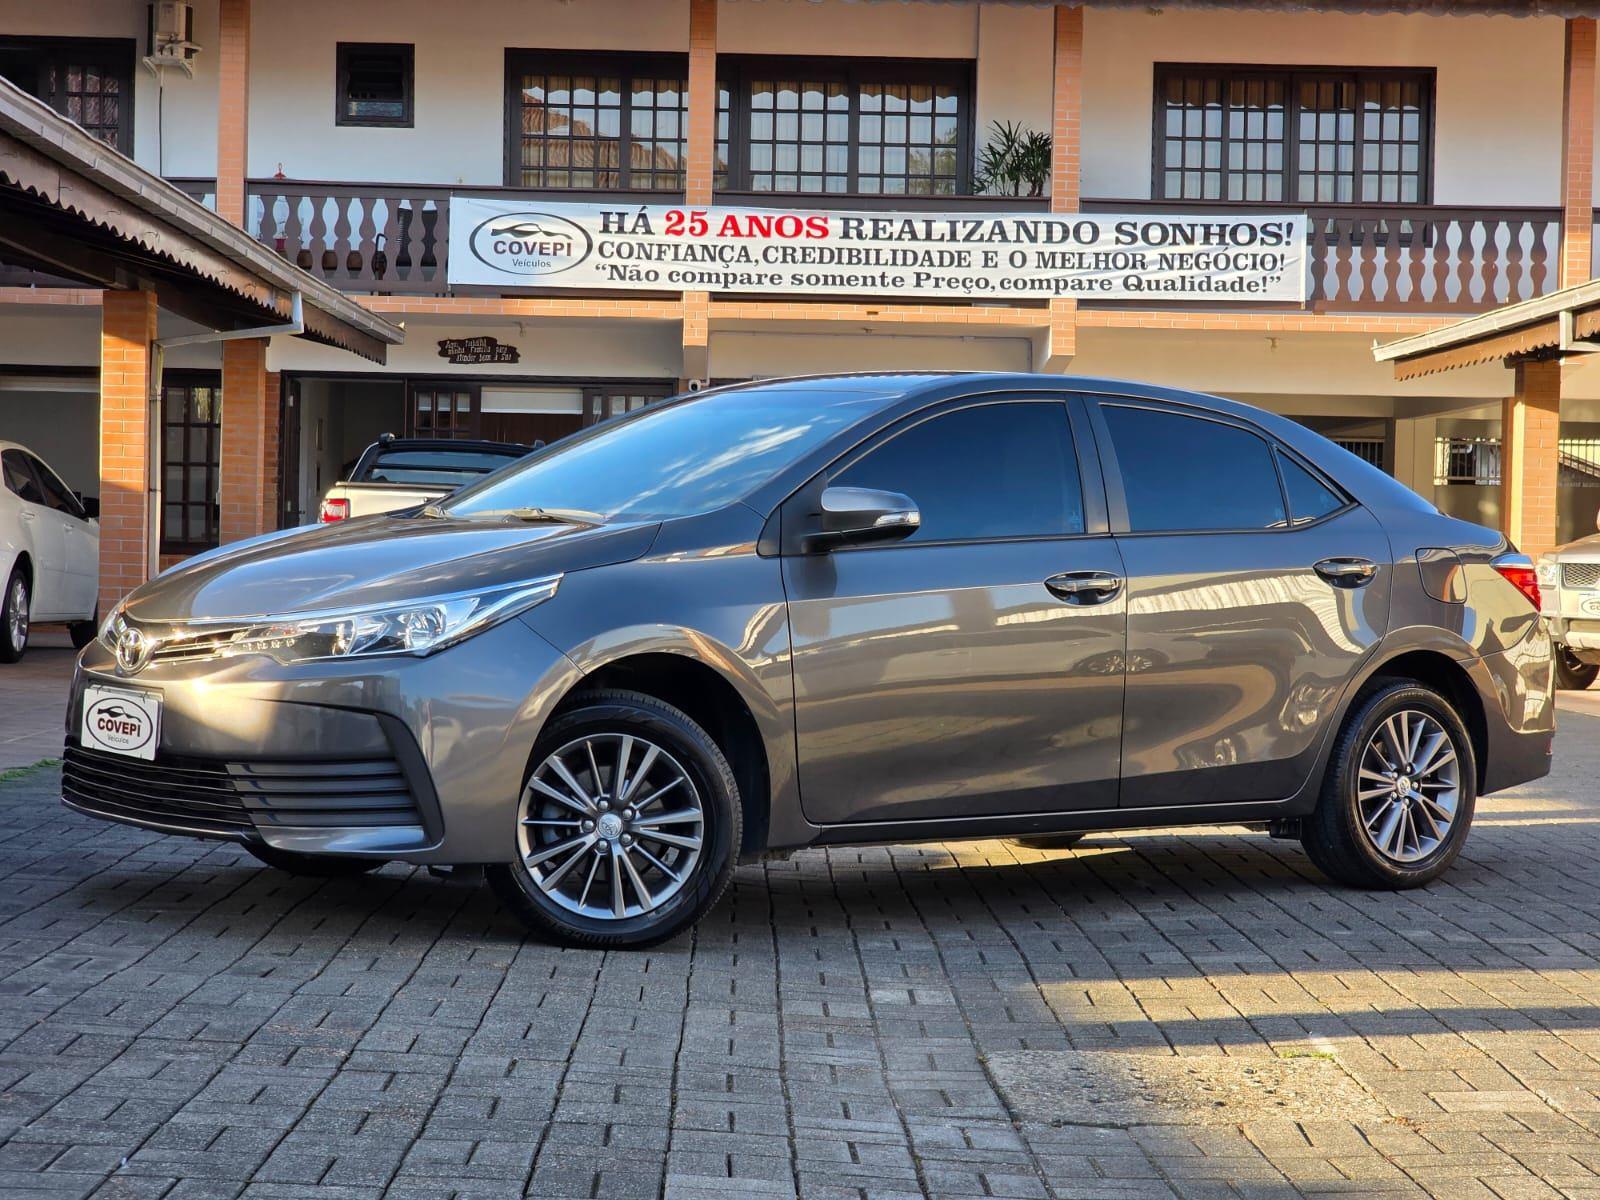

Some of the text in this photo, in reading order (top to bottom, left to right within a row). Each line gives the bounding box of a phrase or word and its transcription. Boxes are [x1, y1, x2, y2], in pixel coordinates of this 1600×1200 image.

[599, 205, 1294, 247] HÁ 25 ANOS REALIZANDO SONHOS!
[493, 239, 572, 257] COVEPI
[512, 258, 552, 268] Veículos
[981, 250, 999, 269] E
[1008, 250, 1028, 269] O
[1035, 250, 1149, 271] MELHOR
[1157, 246, 1285, 272] NEGÓCIO!
[667, 268, 783, 289] compare
[790, 271, 905, 288] somente
[97, 718, 141, 738] COVEPI
